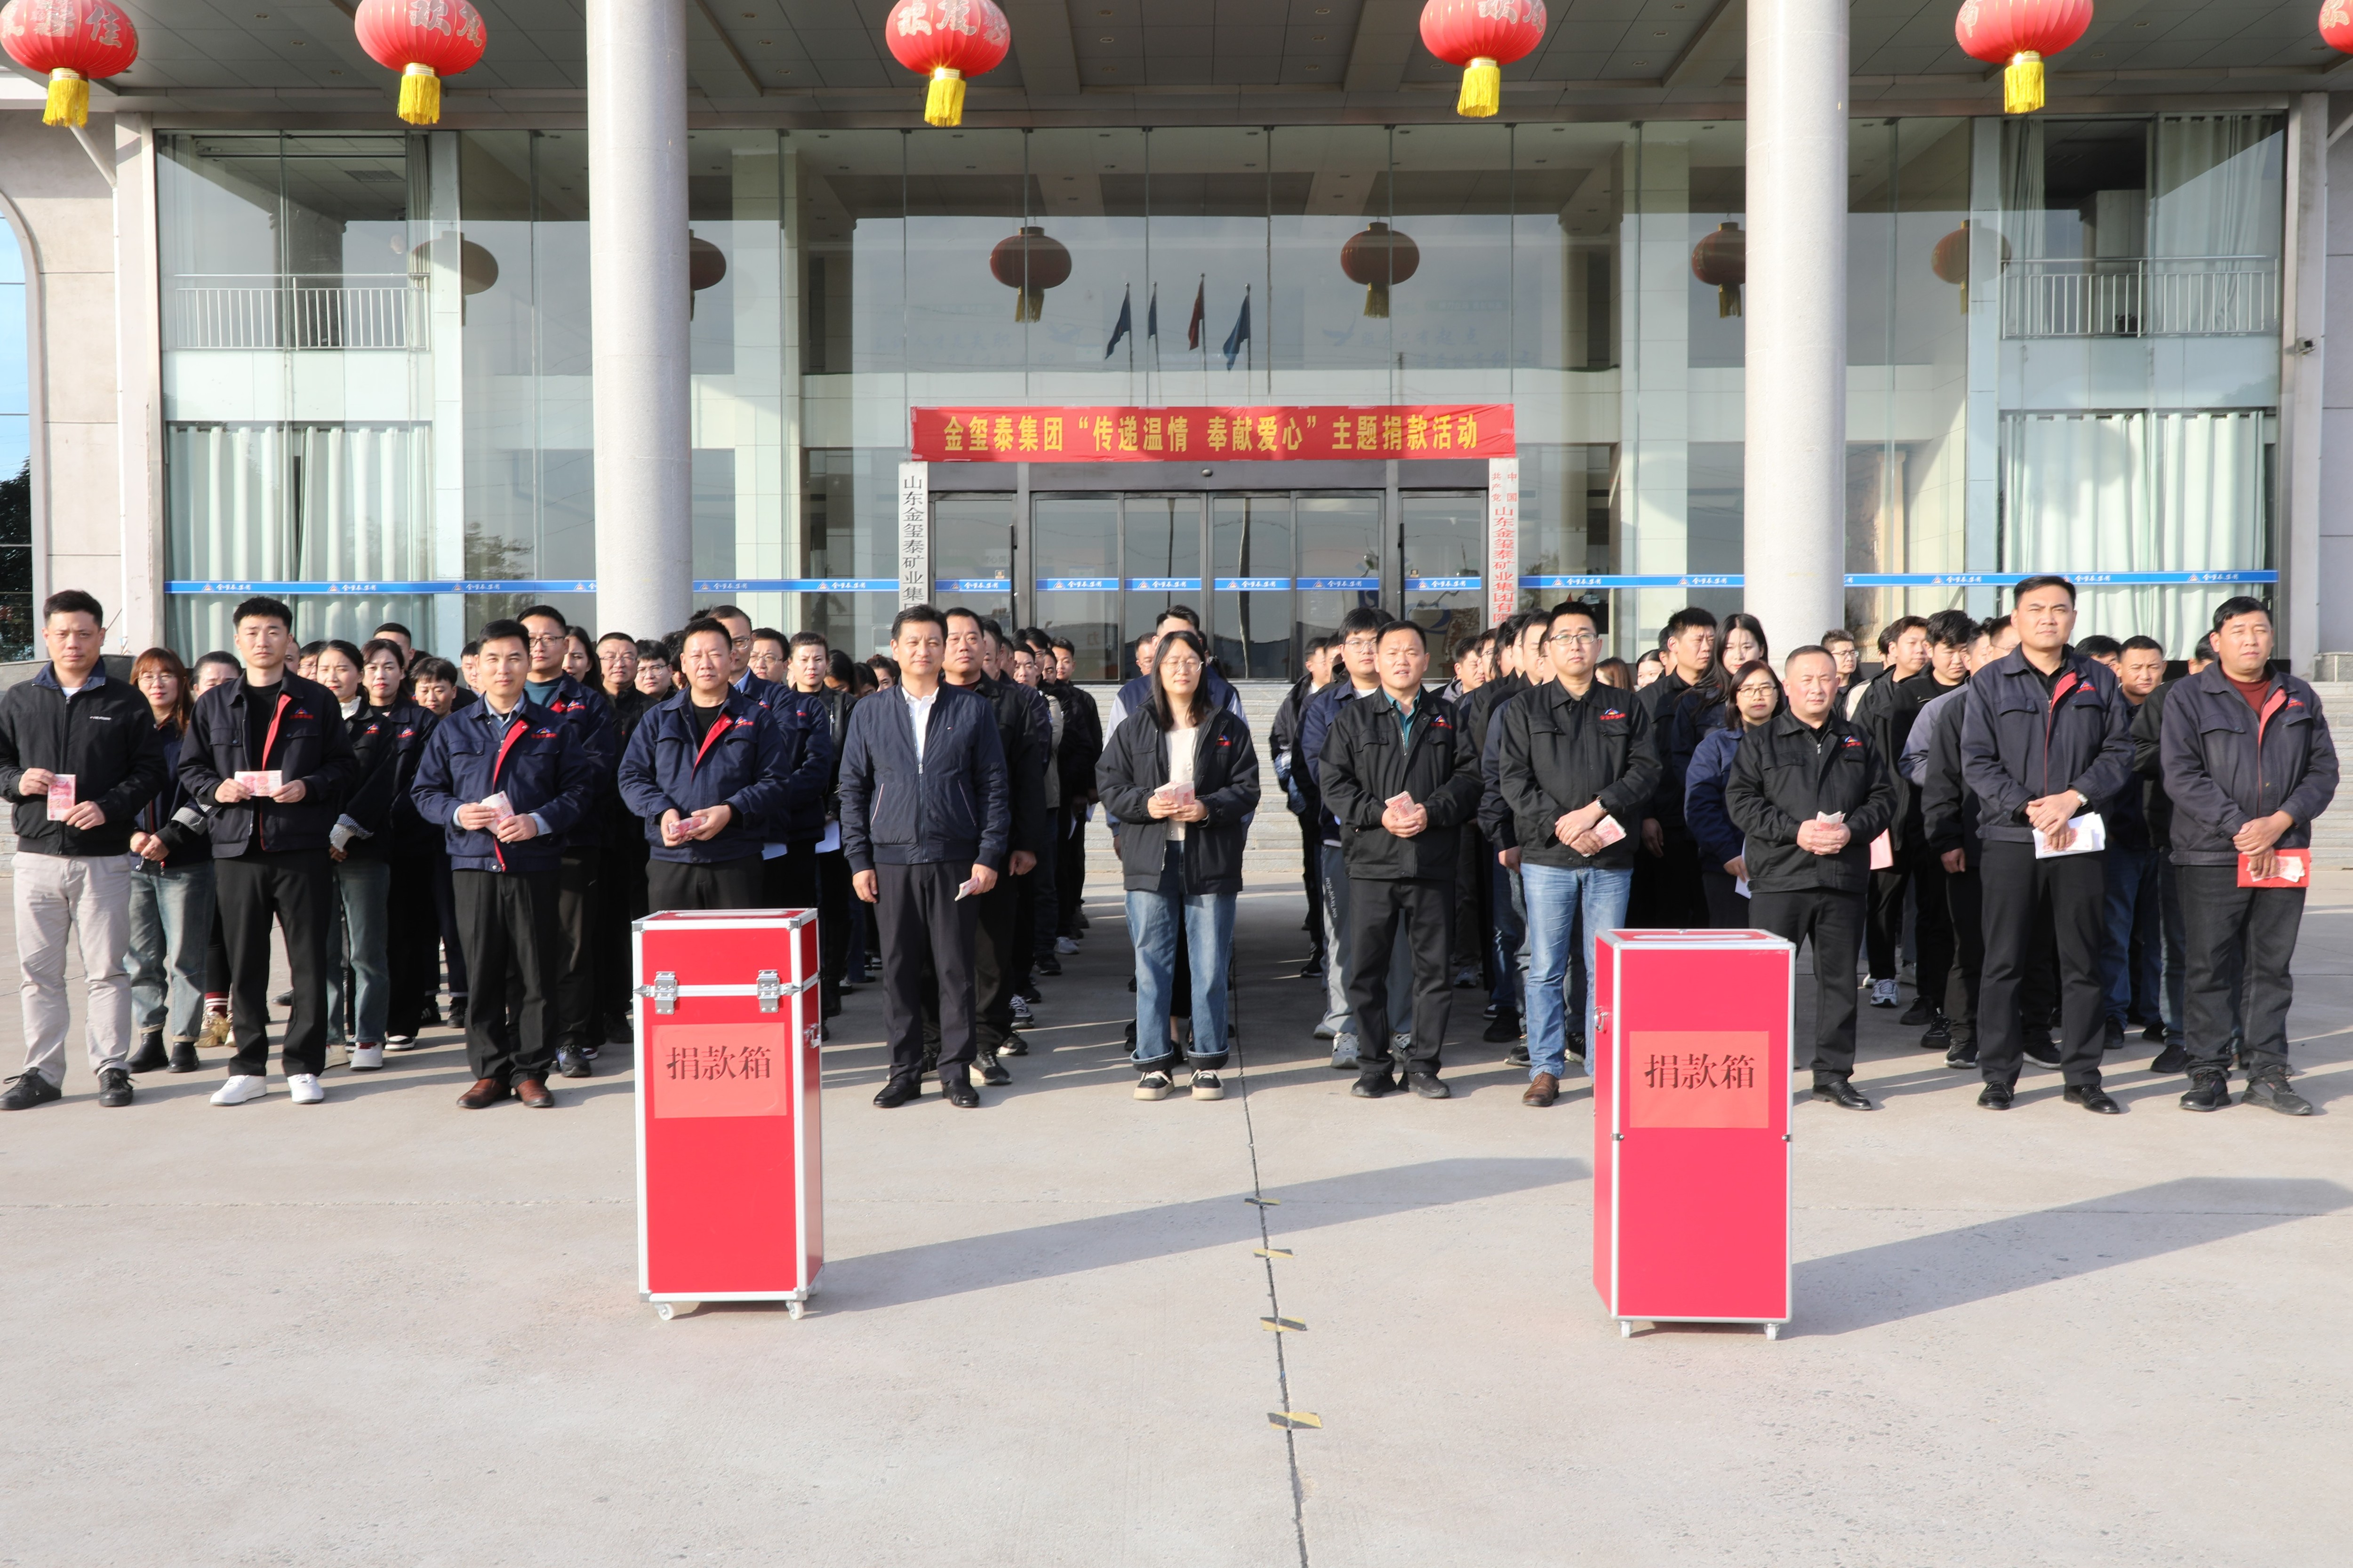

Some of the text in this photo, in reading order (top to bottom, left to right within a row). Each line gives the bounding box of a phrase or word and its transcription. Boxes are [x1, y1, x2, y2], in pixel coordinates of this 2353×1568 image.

[944, 413, 1478, 452] 金玺泰集团 “传递温情 奉献爱心” 主题捐款活动
[666, 1045, 771, 1080] 捐款箱
[1644, 1053, 1755, 1089] 捐款箱
